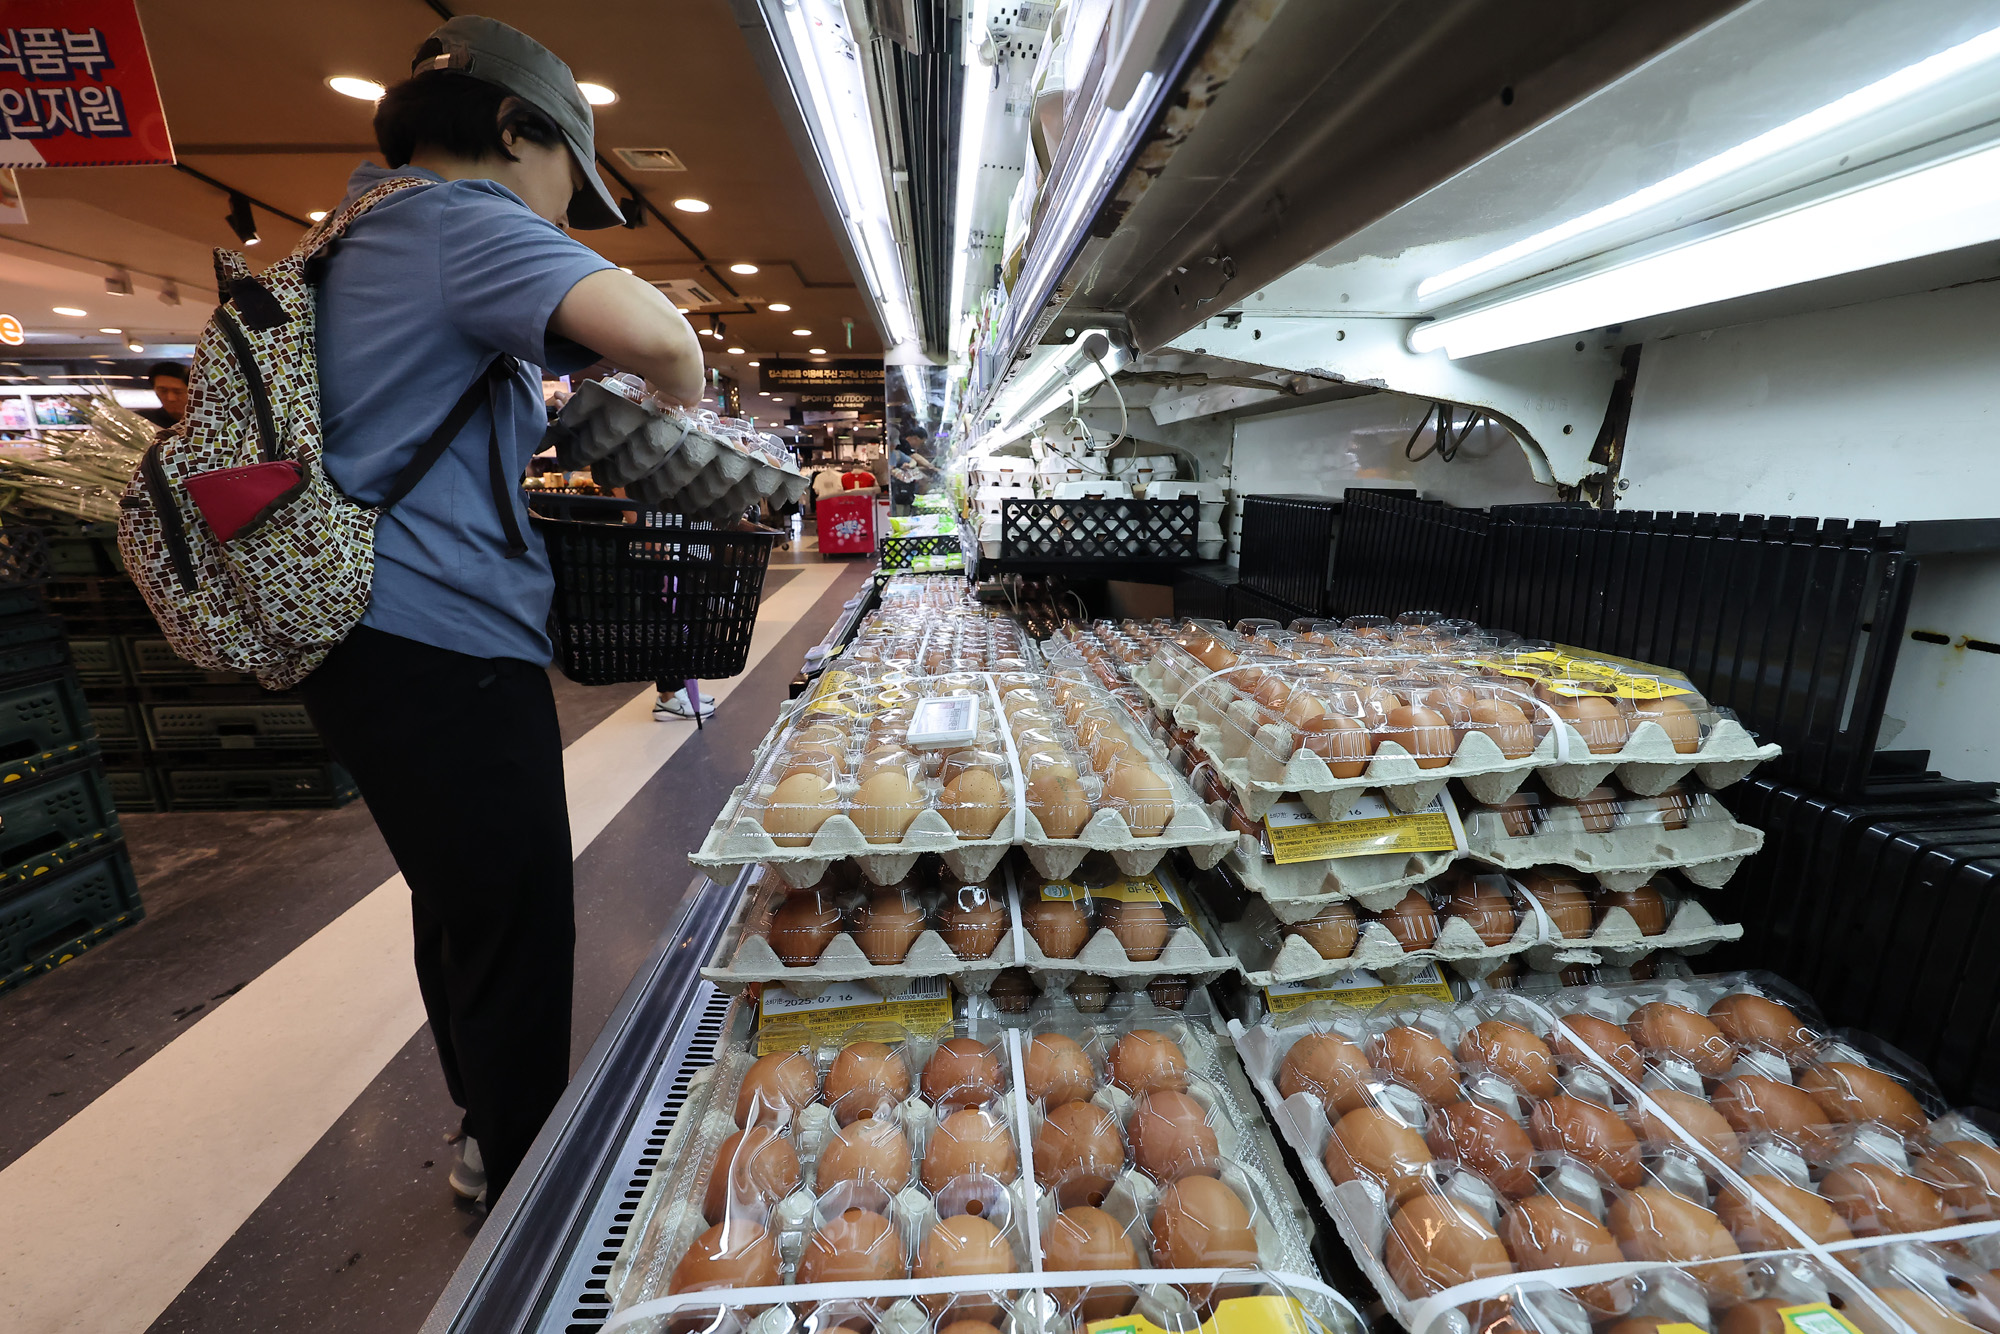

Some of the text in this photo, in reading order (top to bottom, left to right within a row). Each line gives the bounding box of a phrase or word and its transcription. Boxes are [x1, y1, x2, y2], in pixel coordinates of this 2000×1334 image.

[0, 27, 107, 77] 식품부
[0, 85, 124, 134] 인지원
[801, 395, 832, 403] SPORTS
[834, 395, 873, 403] OUTDOOR
[784, 997, 814, 1007] 2025.
[817, 995, 834, 1004] 07.
